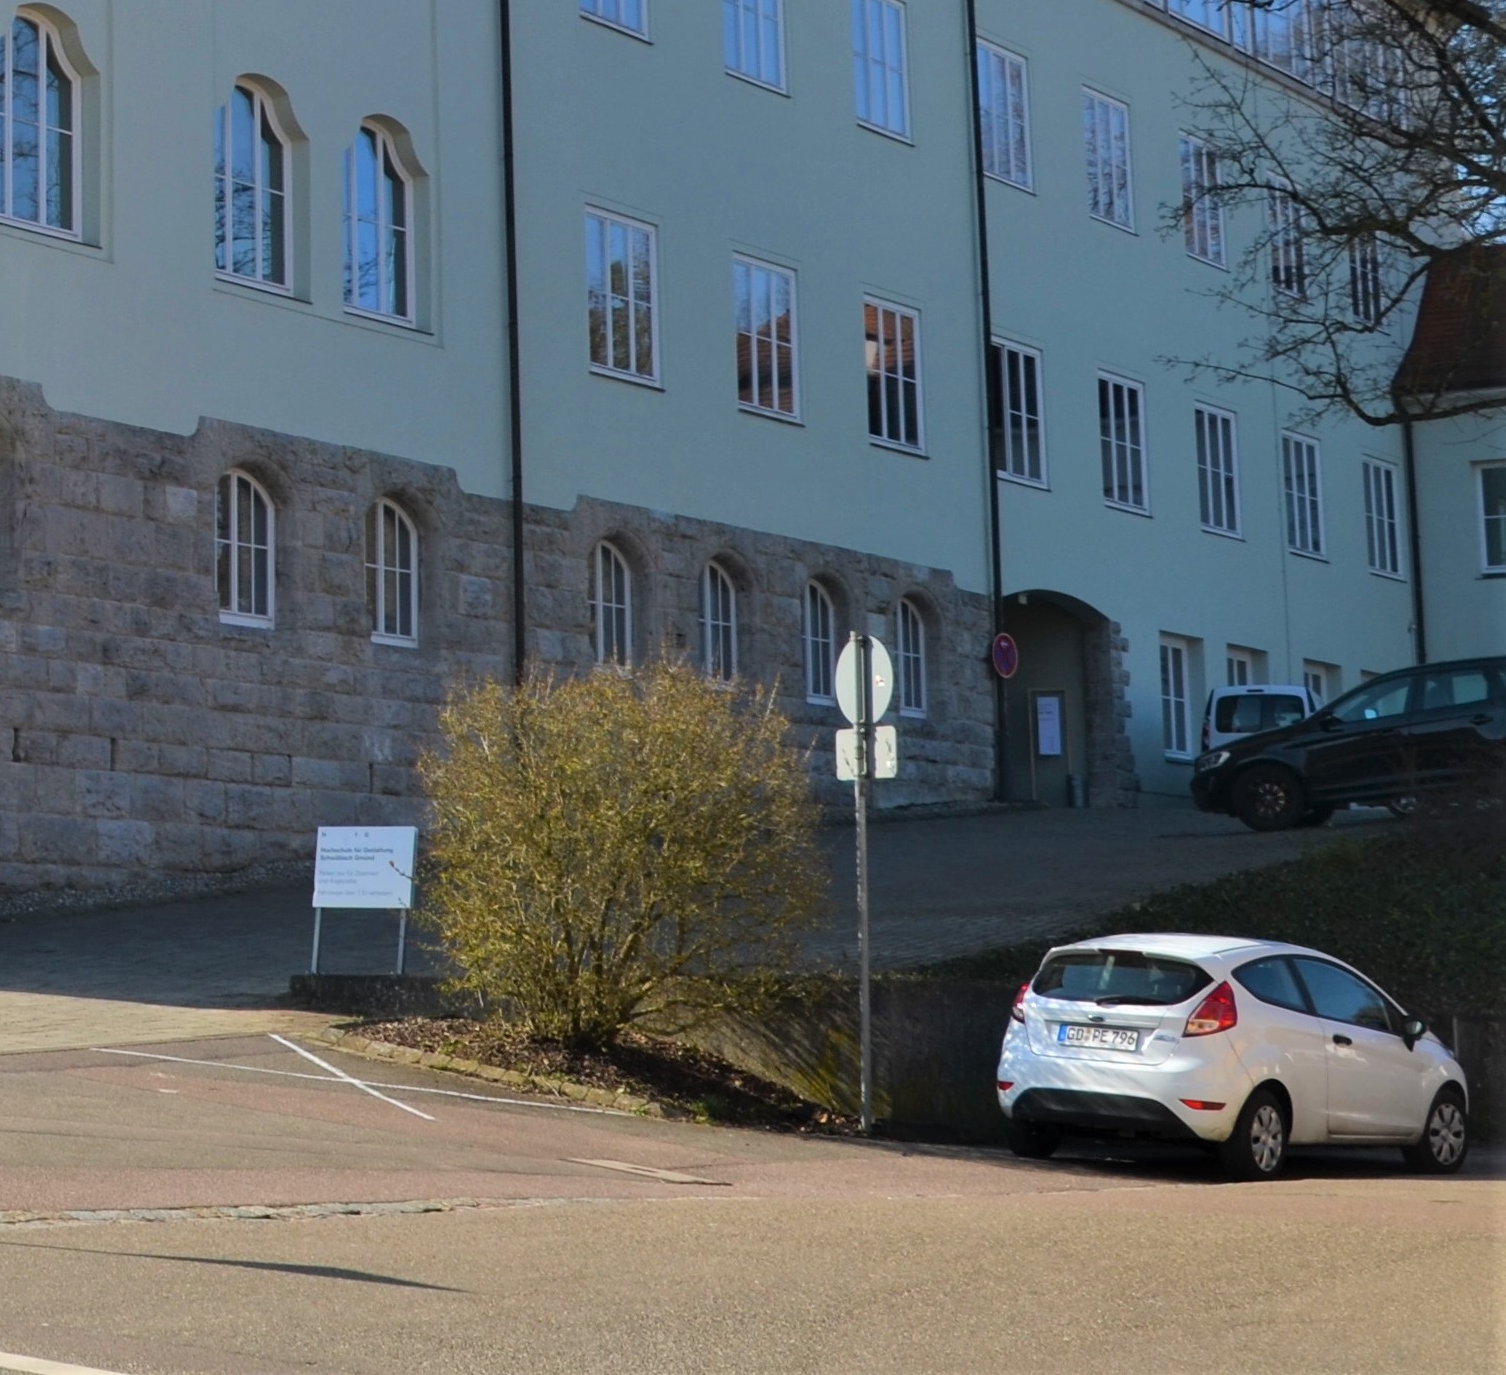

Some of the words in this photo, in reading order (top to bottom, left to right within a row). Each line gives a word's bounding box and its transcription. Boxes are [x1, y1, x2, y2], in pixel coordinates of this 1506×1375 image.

[1067, 1027, 1085, 1041] GD
[1092, 1029, 1108, 1043] PE
[1112, 1031, 1136, 1045] 796
